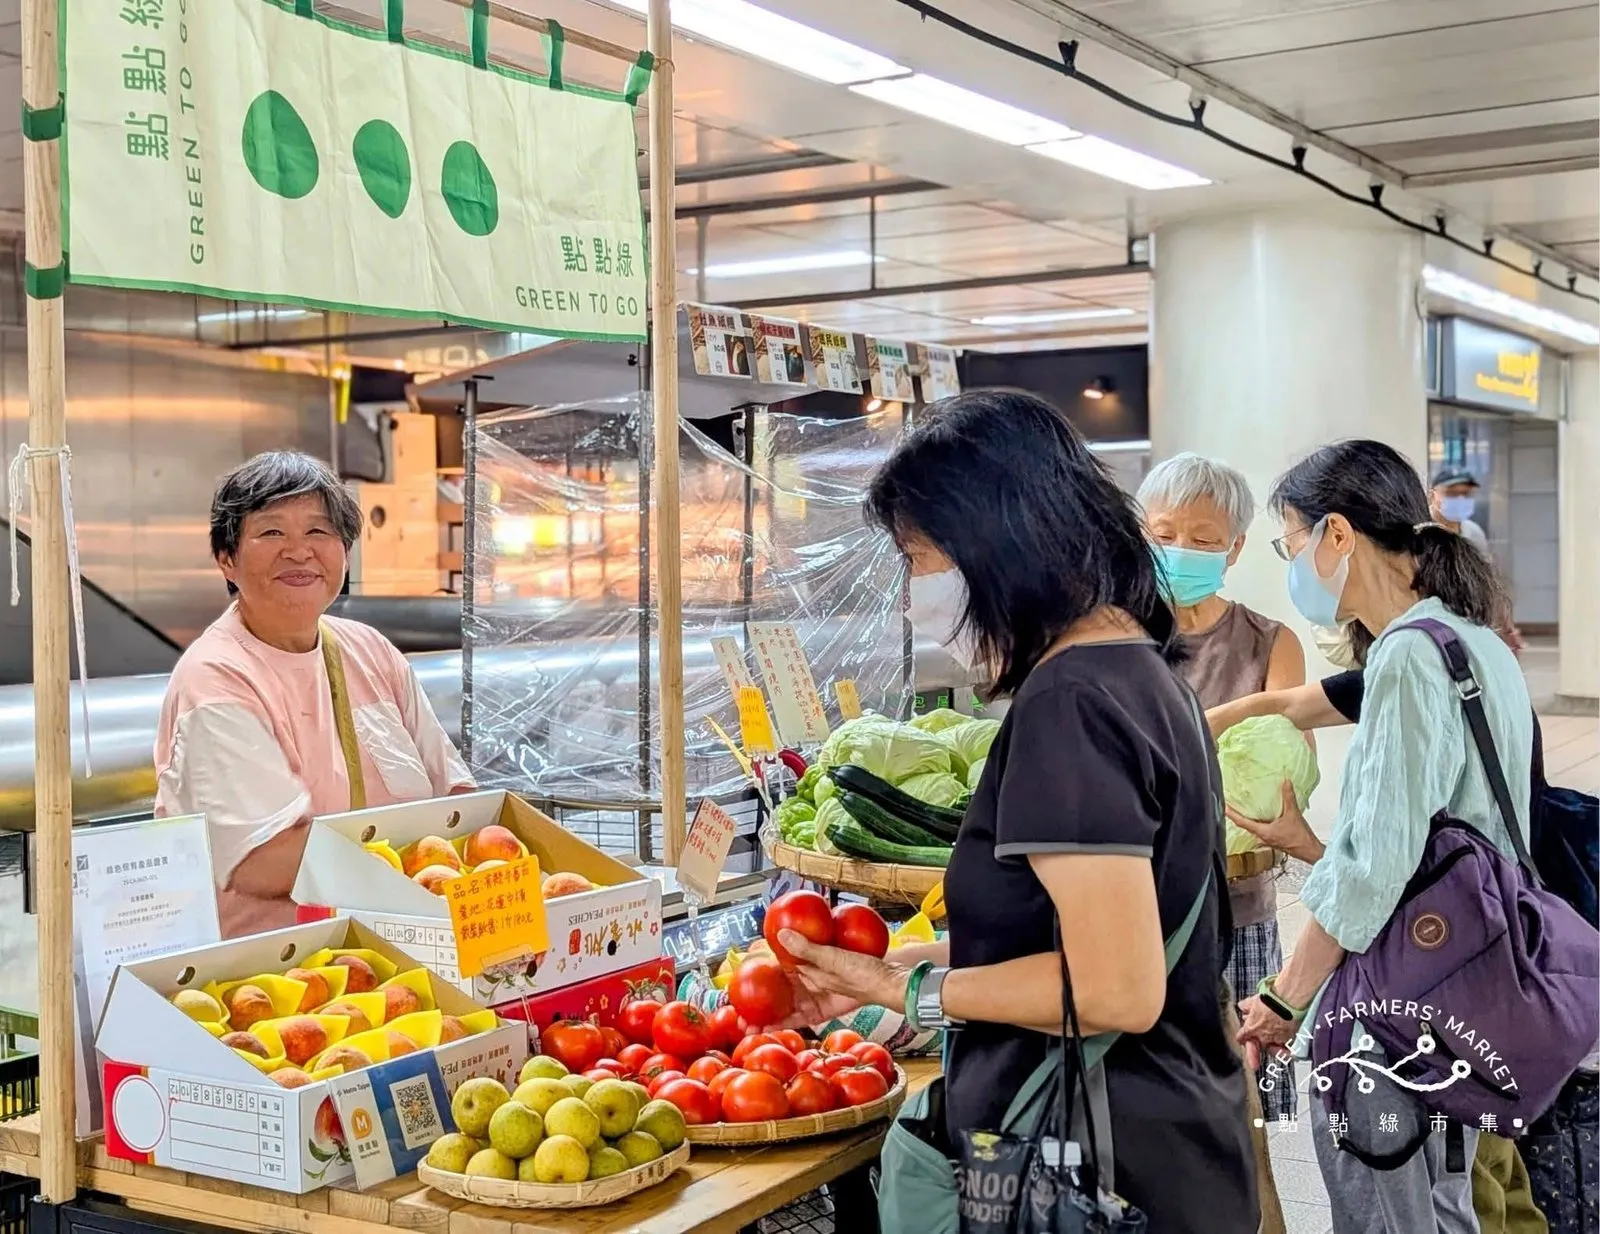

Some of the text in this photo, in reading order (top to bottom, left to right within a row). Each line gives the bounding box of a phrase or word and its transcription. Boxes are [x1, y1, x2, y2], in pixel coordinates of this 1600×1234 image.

[180, 67, 194, 115] TO
[183, 138, 204, 264] GREEN
[560, 235, 634, 277] 點點綠
[515, 285, 638, 316] GREEN TO GO
[568, 908, 604, 926] PEACHES
[169, 1083, 180, 1095] 12
[181, 1084, 190, 1097] 10
[203, 1089, 211, 1101] 8
[226, 1092, 233, 1104] 6
[249, 1096, 255, 1109] 5
